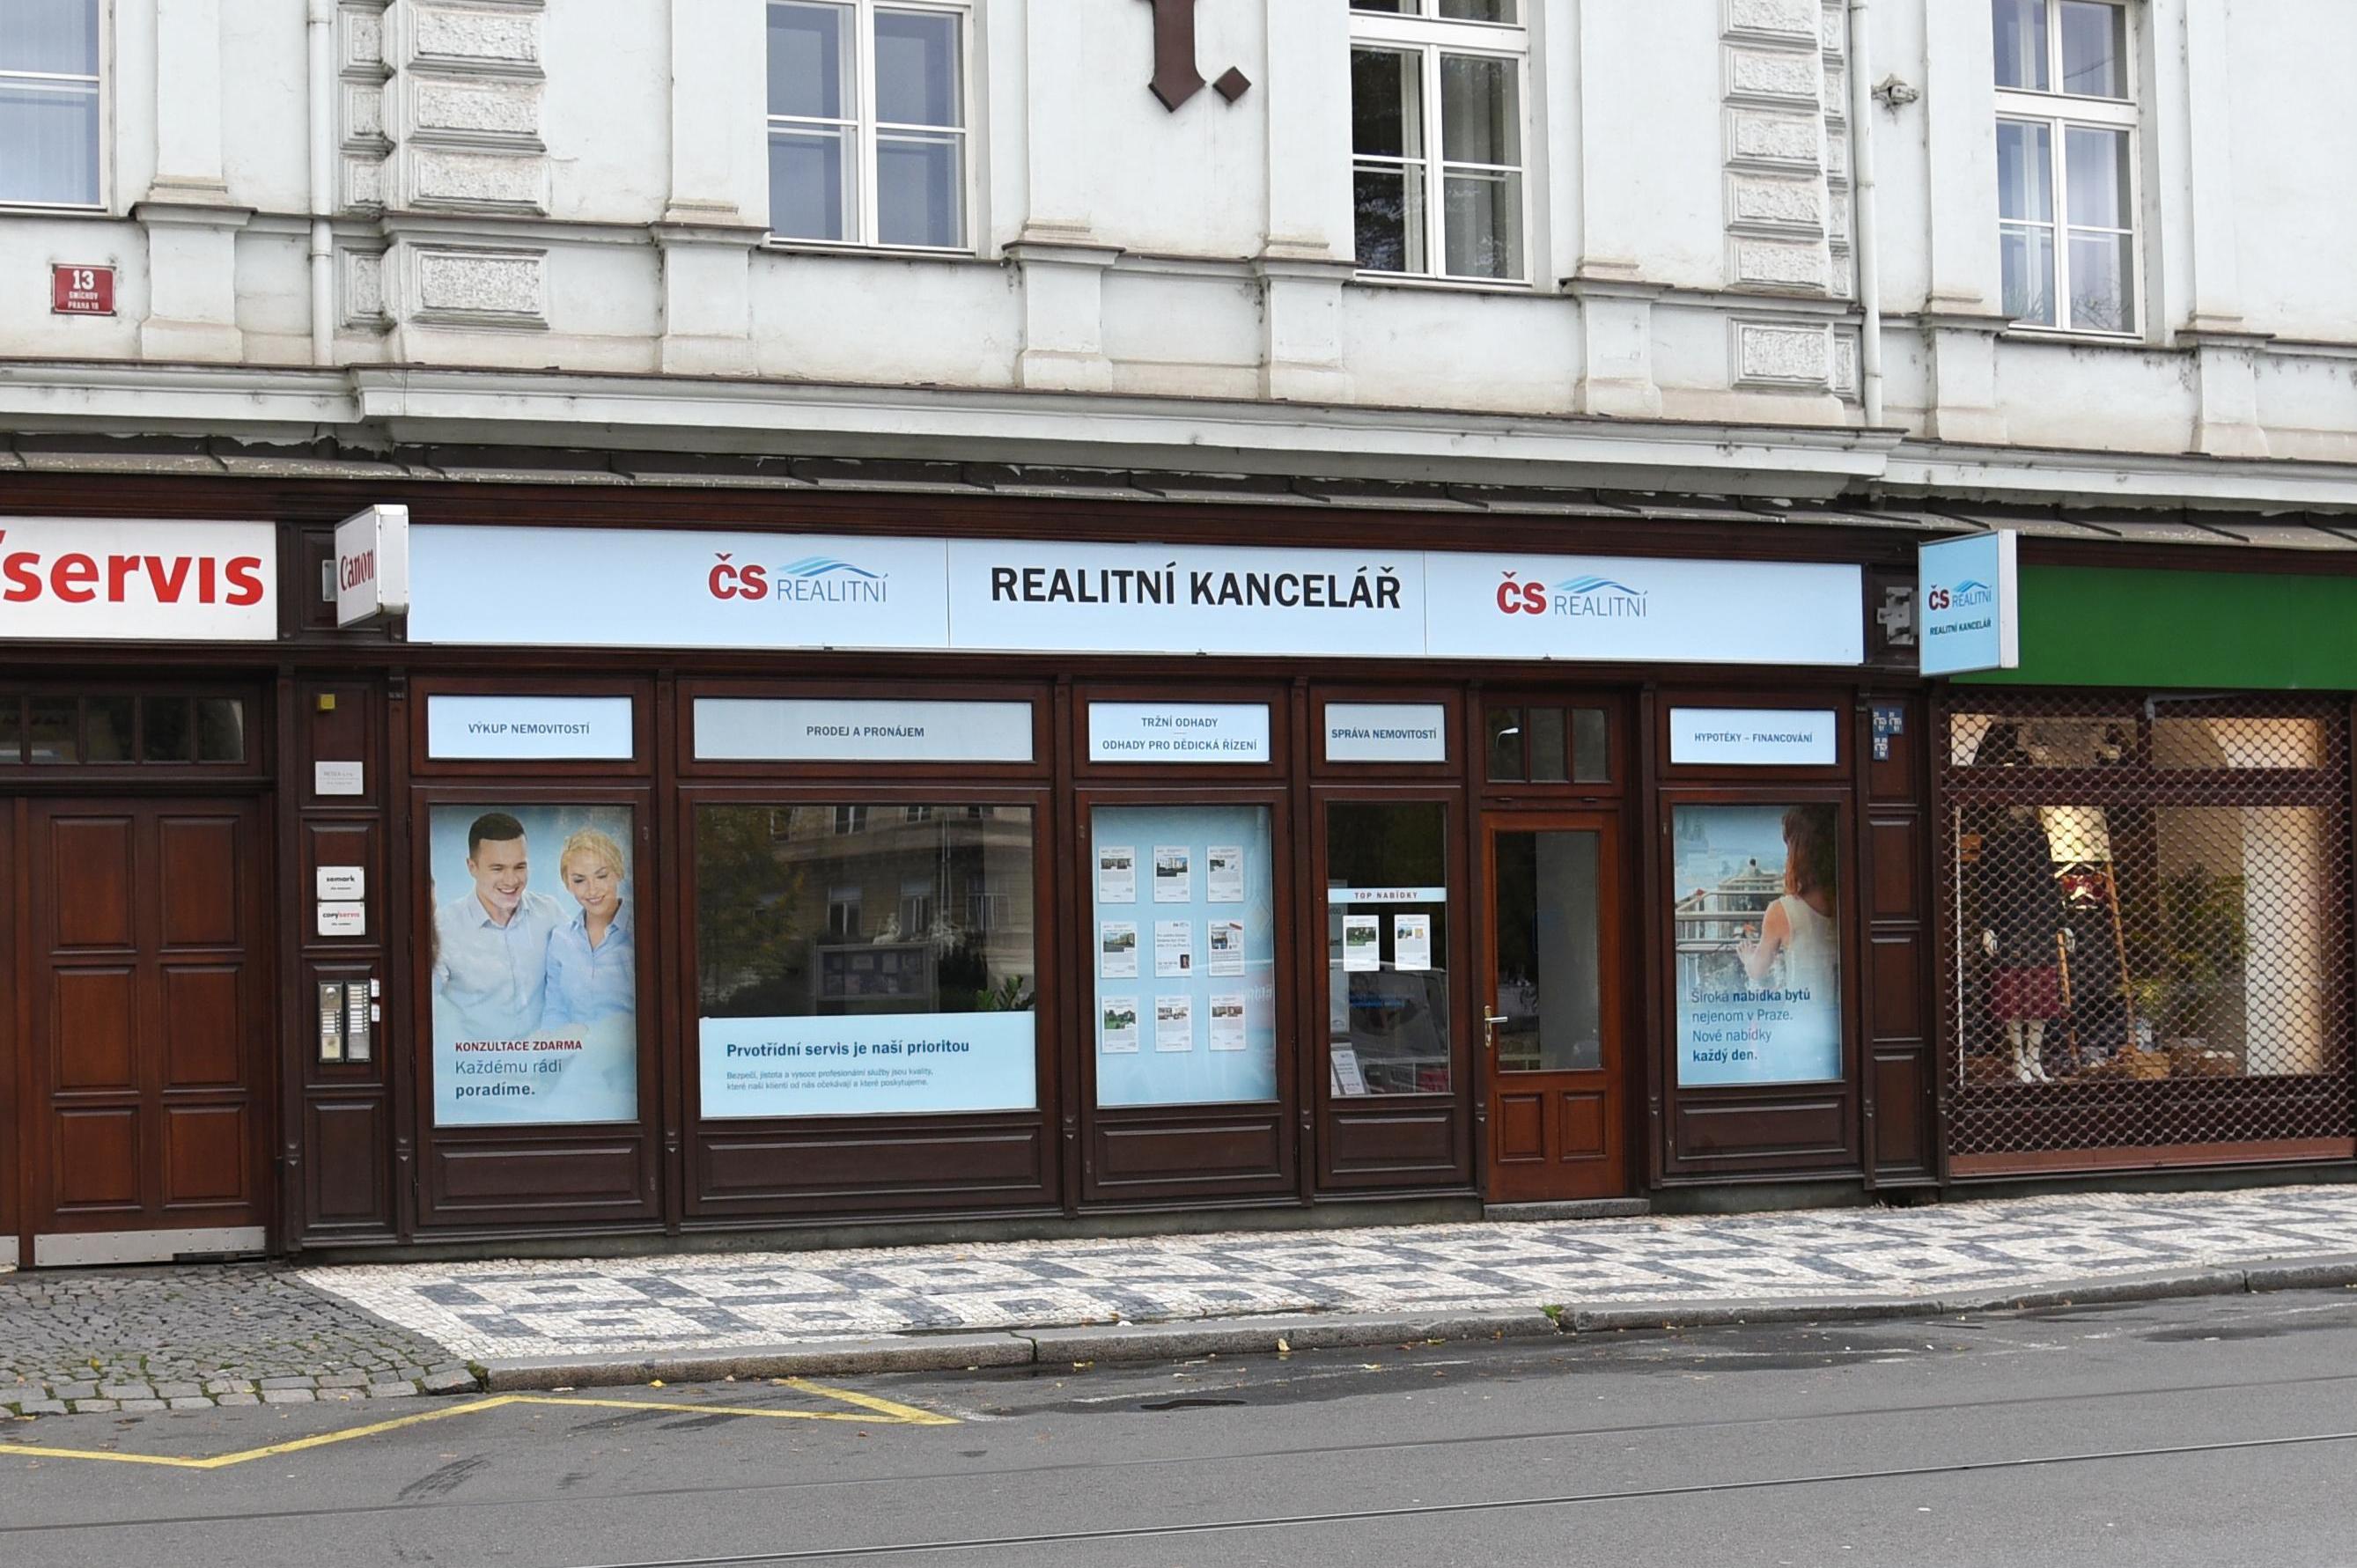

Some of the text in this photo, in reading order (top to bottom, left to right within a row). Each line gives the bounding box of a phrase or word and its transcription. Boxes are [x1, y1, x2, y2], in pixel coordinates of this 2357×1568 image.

[73, 270, 94, 290] 13
[341, 549, 374, 591] Canon
[709, 554, 888, 602] ČS REALITNÍ
[991, 562, 1400, 608] REALITNÍ KANCELÁŘ
[1497, 571, 1647, 617] ČS REALITNÍ
[1929, 585, 1992, 610] ČS REALITNÍ
[1930, 618, 1992, 635] REALITNÍ KANCELÁŘ
[468, 720, 590, 735] VÝKUP NEMOVITOSTÍ
[1141, 715, 1219, 728] TRŽNÍ ODHADY
[807, 724, 924, 739] PRODEJ A PRONÁJEM
[1332, 726, 1436, 740] SPRÁVA NEMOVITOSTÍ
[1695, 731, 1741, 744] HYPOTÉKY
[1752, 732, 1812, 744] FINANCOVÁNÍ
[1102, 738, 1257, 752] ODHADY PRO DĚDICKÁ ŘÍZENÍ
[1377, 890, 1418, 899] NABÍDKY
[1691, 988, 1810, 1004] Široká nabídka bytů
[1692, 1010, 1743, 1025] nejenom
[1757, 1009, 1793, 1020] Praze.
[1693, 1027, 1771, 1042] Nové nabídky
[456, 1041, 582, 1051] KONZULTACE ZDARMA
[727, 1040, 969, 1057] Prvotřídní servis je naší prioritou
[1693, 1049, 1757, 1064] každý den.
[456, 1059, 562, 1075] Každému rádi
[456, 1082, 535, 1099] poradíme.
